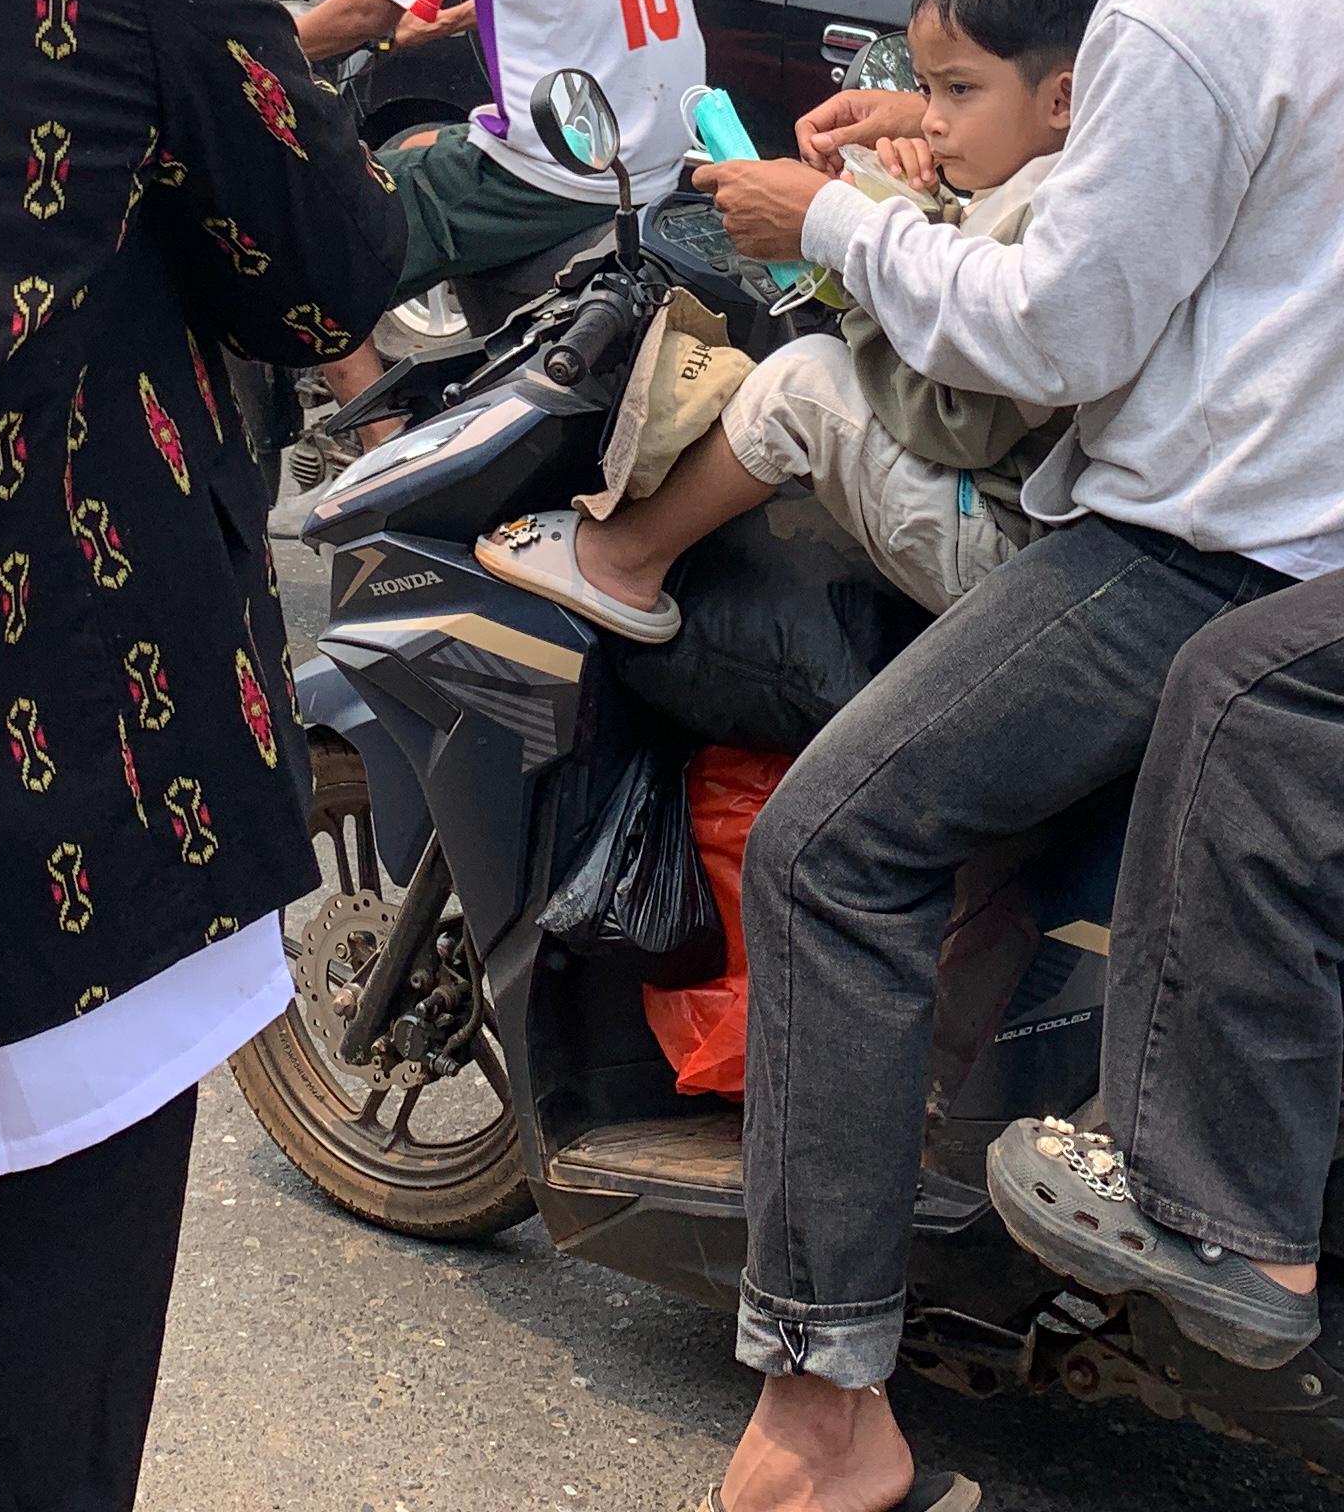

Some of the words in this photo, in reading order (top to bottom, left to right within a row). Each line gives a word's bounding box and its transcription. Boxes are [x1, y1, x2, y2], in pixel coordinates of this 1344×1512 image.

[368, 570, 444, 597] HONDA
[994, 1026, 1034, 1043] LIQUID
[1036, 1011, 1092, 1033] COOLED
